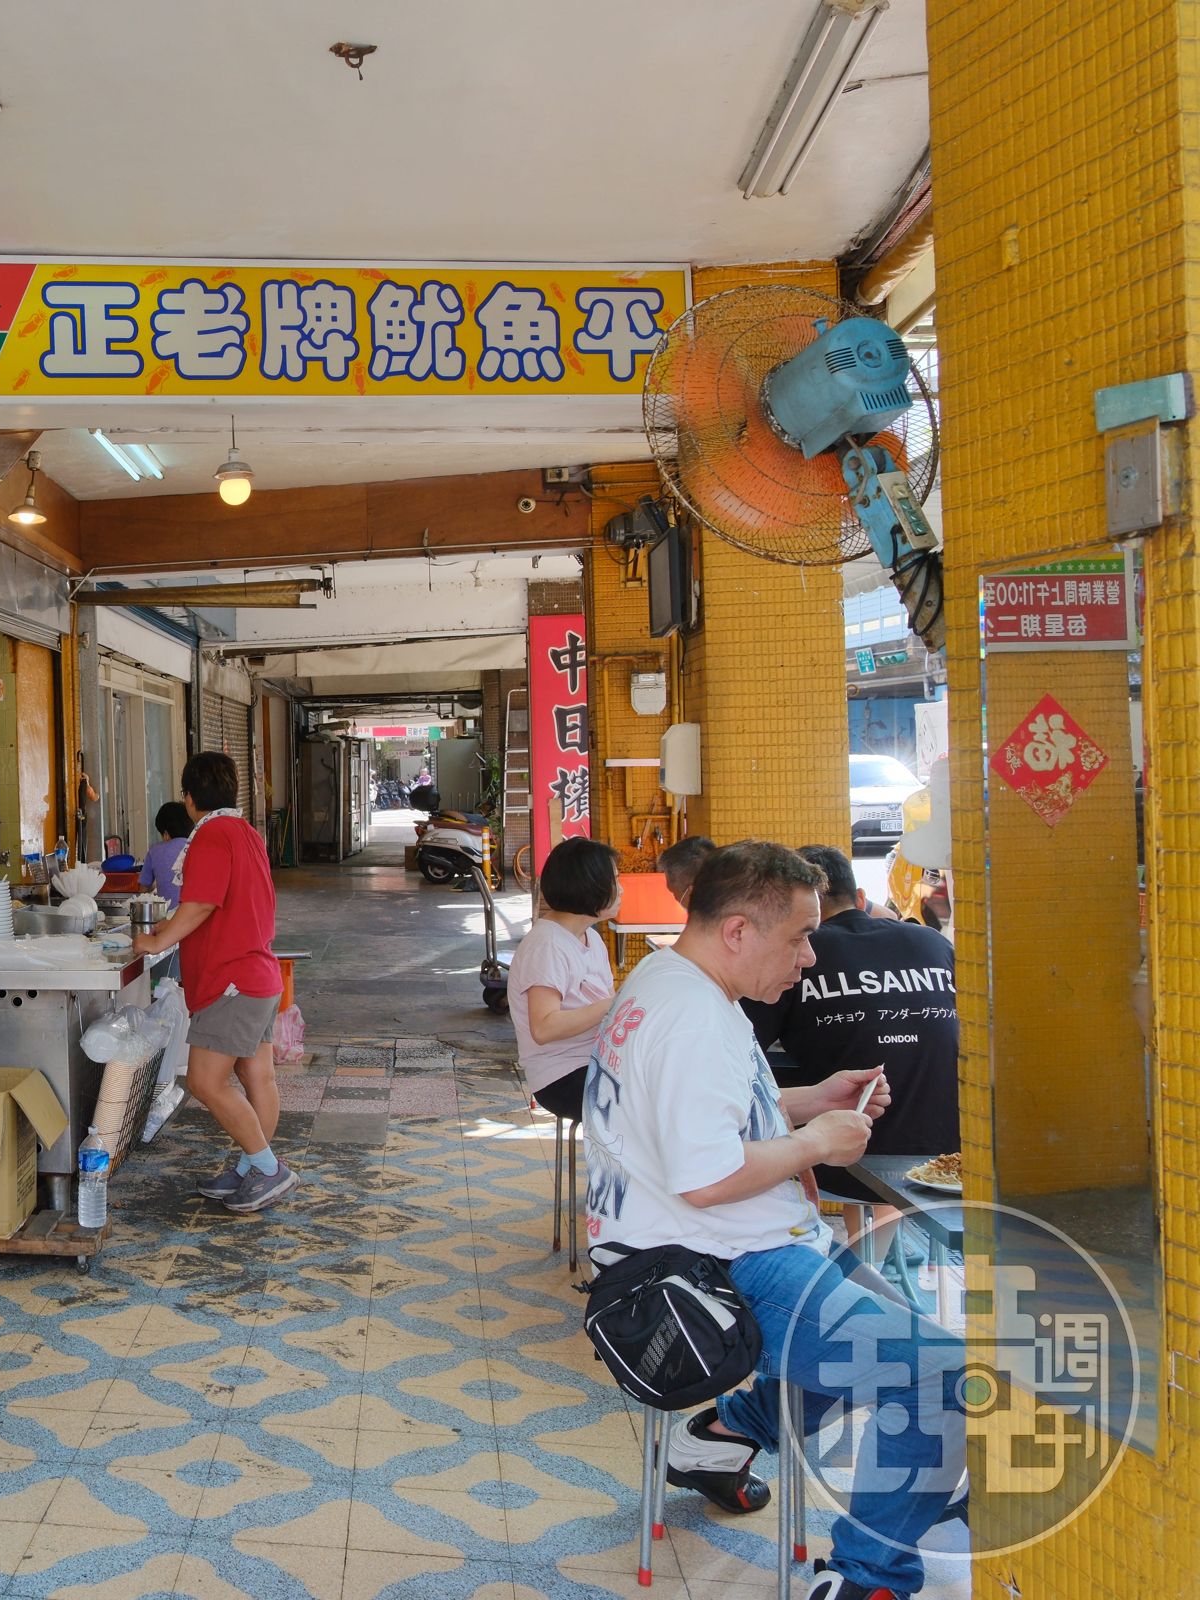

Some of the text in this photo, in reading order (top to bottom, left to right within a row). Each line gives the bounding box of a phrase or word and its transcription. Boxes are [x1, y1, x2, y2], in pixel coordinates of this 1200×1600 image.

[39, 279, 668, 382] 正老牌魷魚平
[801, 967, 956, 1003] ALLSAINTS
[816, 1010, 865, 1027] トウキョウ
[877, 1034, 919, 1044] LONDON
